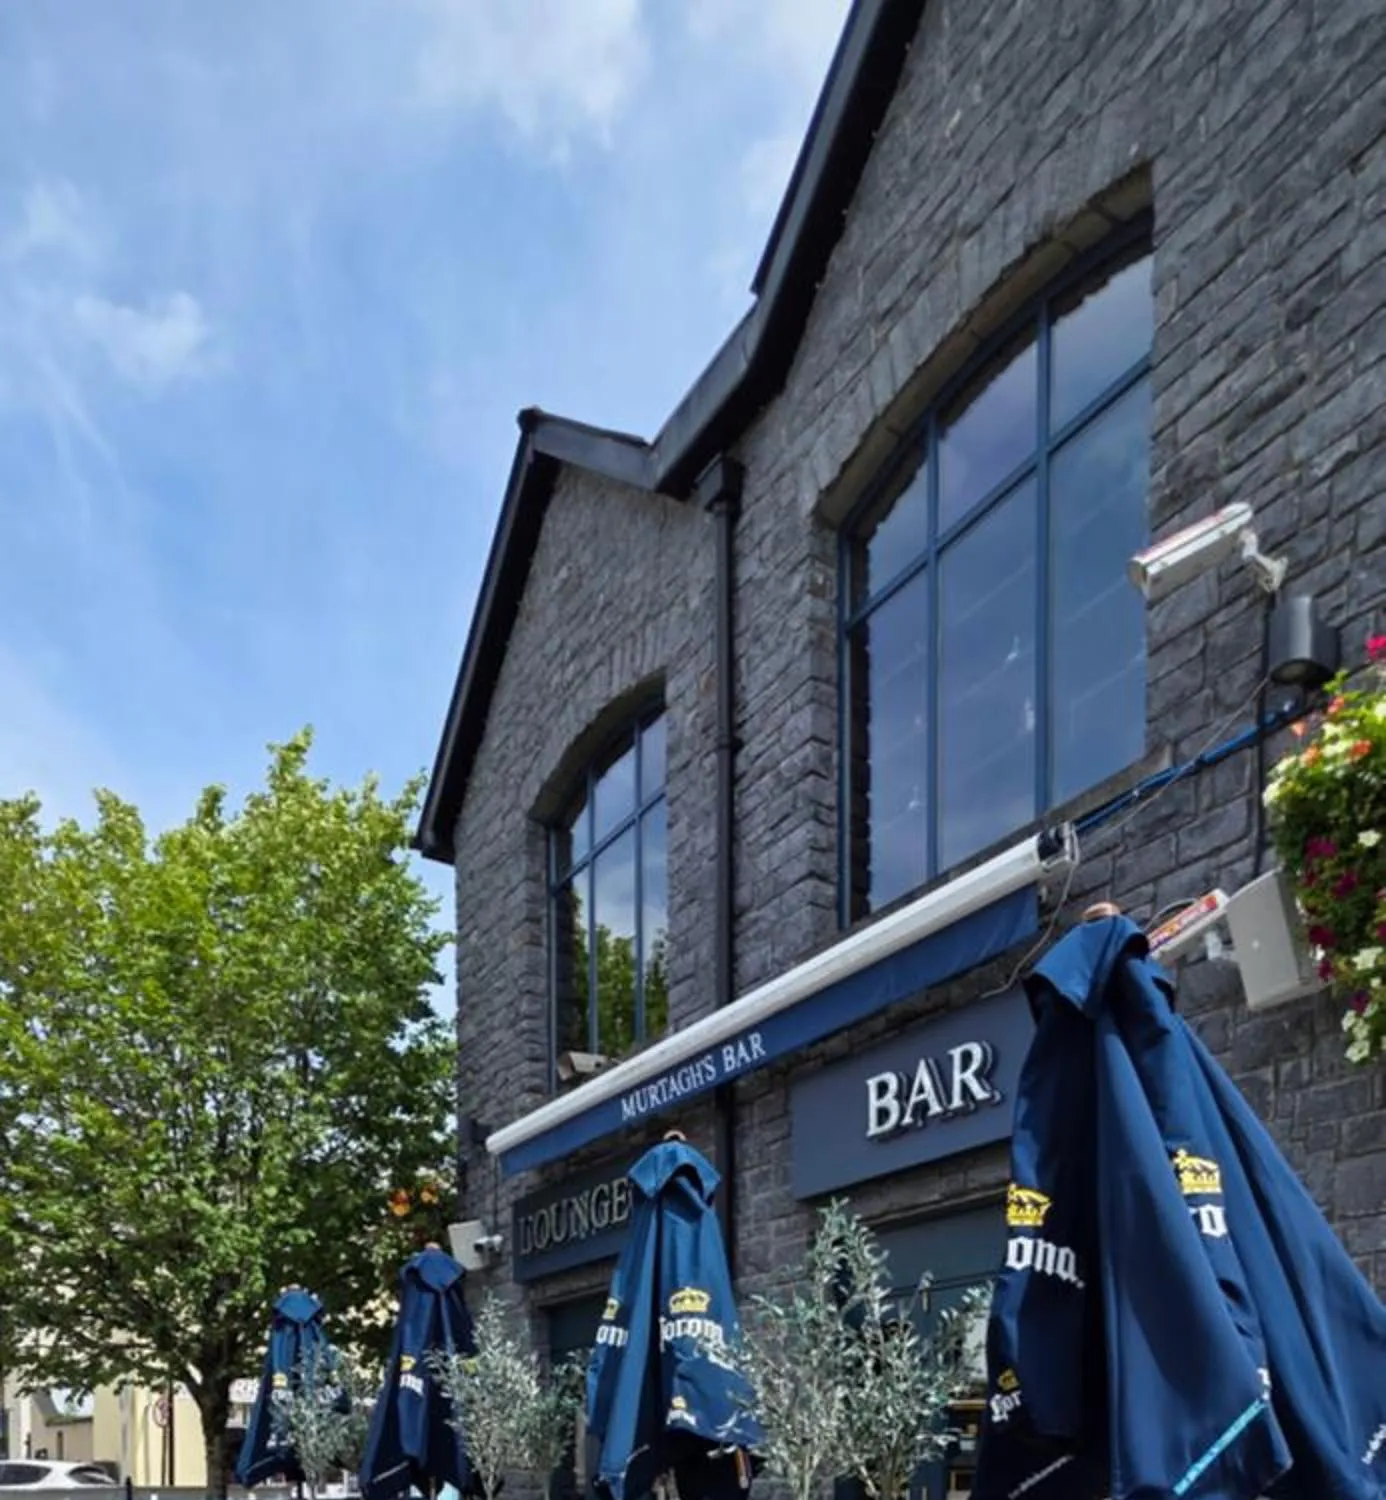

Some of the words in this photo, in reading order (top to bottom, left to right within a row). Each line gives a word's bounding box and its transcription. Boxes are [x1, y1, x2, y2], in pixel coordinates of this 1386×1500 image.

[621, 1055, 717, 1121] MURTAGH'S
[722, 1032, 767, 1072] BAR
[866, 1041, 992, 1138] BAR
[518, 1177, 632, 1255] LOUNGE
[1006, 1236, 1077, 1282] ona
